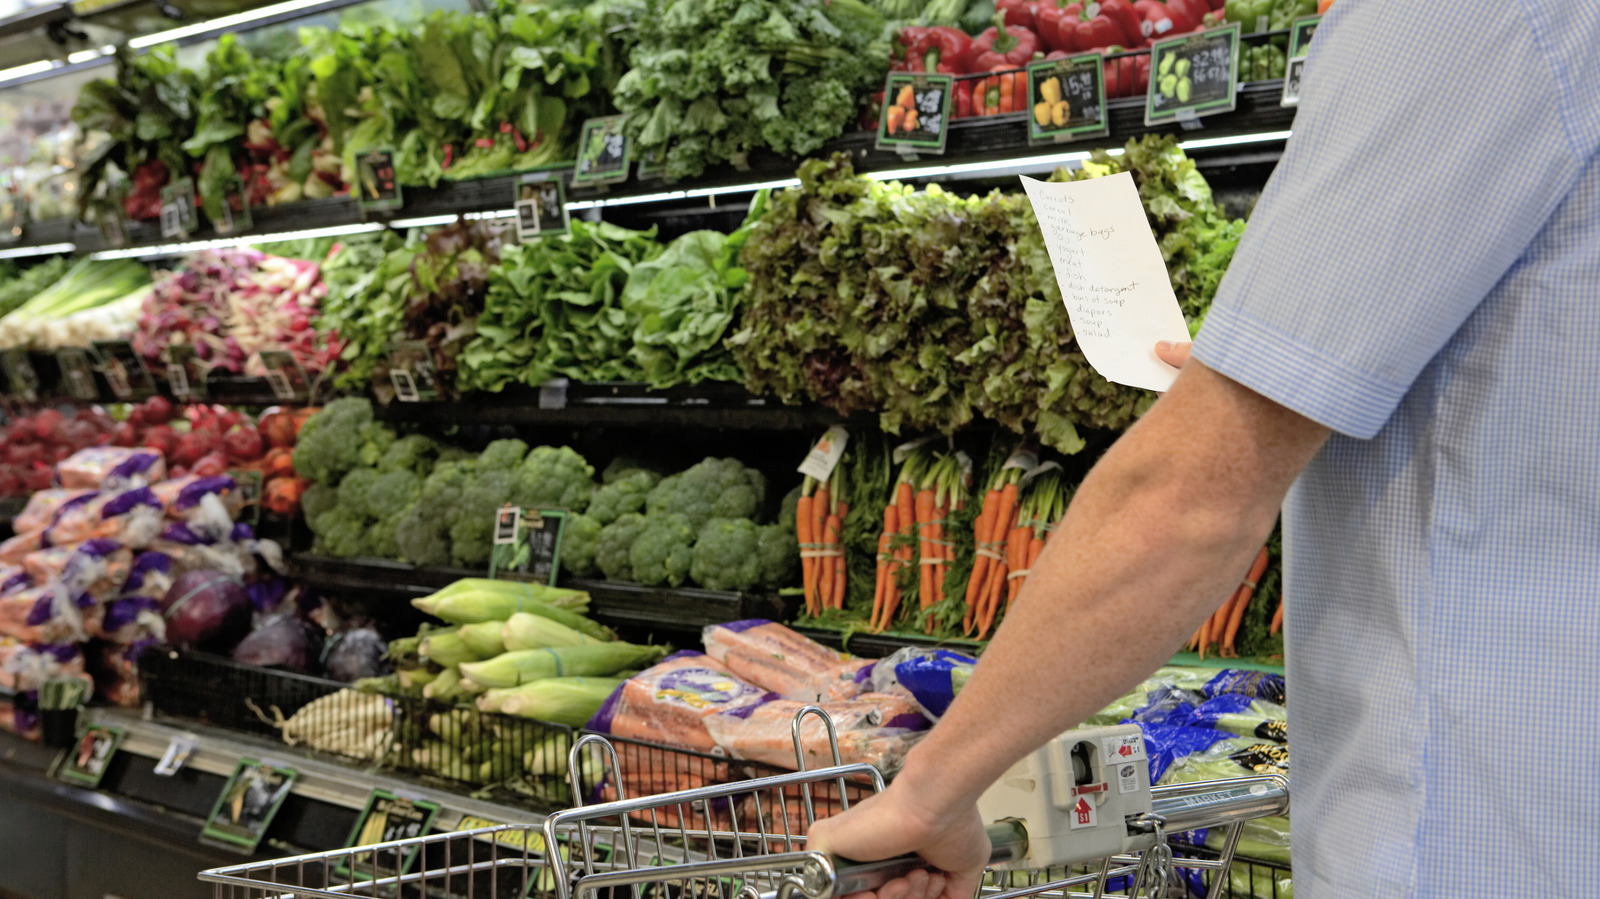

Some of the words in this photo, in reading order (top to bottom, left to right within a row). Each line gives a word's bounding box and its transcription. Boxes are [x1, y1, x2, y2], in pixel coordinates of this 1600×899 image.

[1050, 223, 1087, 241] garbage
[1090, 224, 1115, 240] bags
[1059, 256, 1083, 269] meat
[1068, 281, 1085, 291] dish
[1072, 292, 1089, 302] bars
[1091, 294, 1101, 303] of
[1103, 297, 1126, 307] soap
[1183, 791, 1235, 808] MARKET
[1079, 812, 1089, 823] $1
